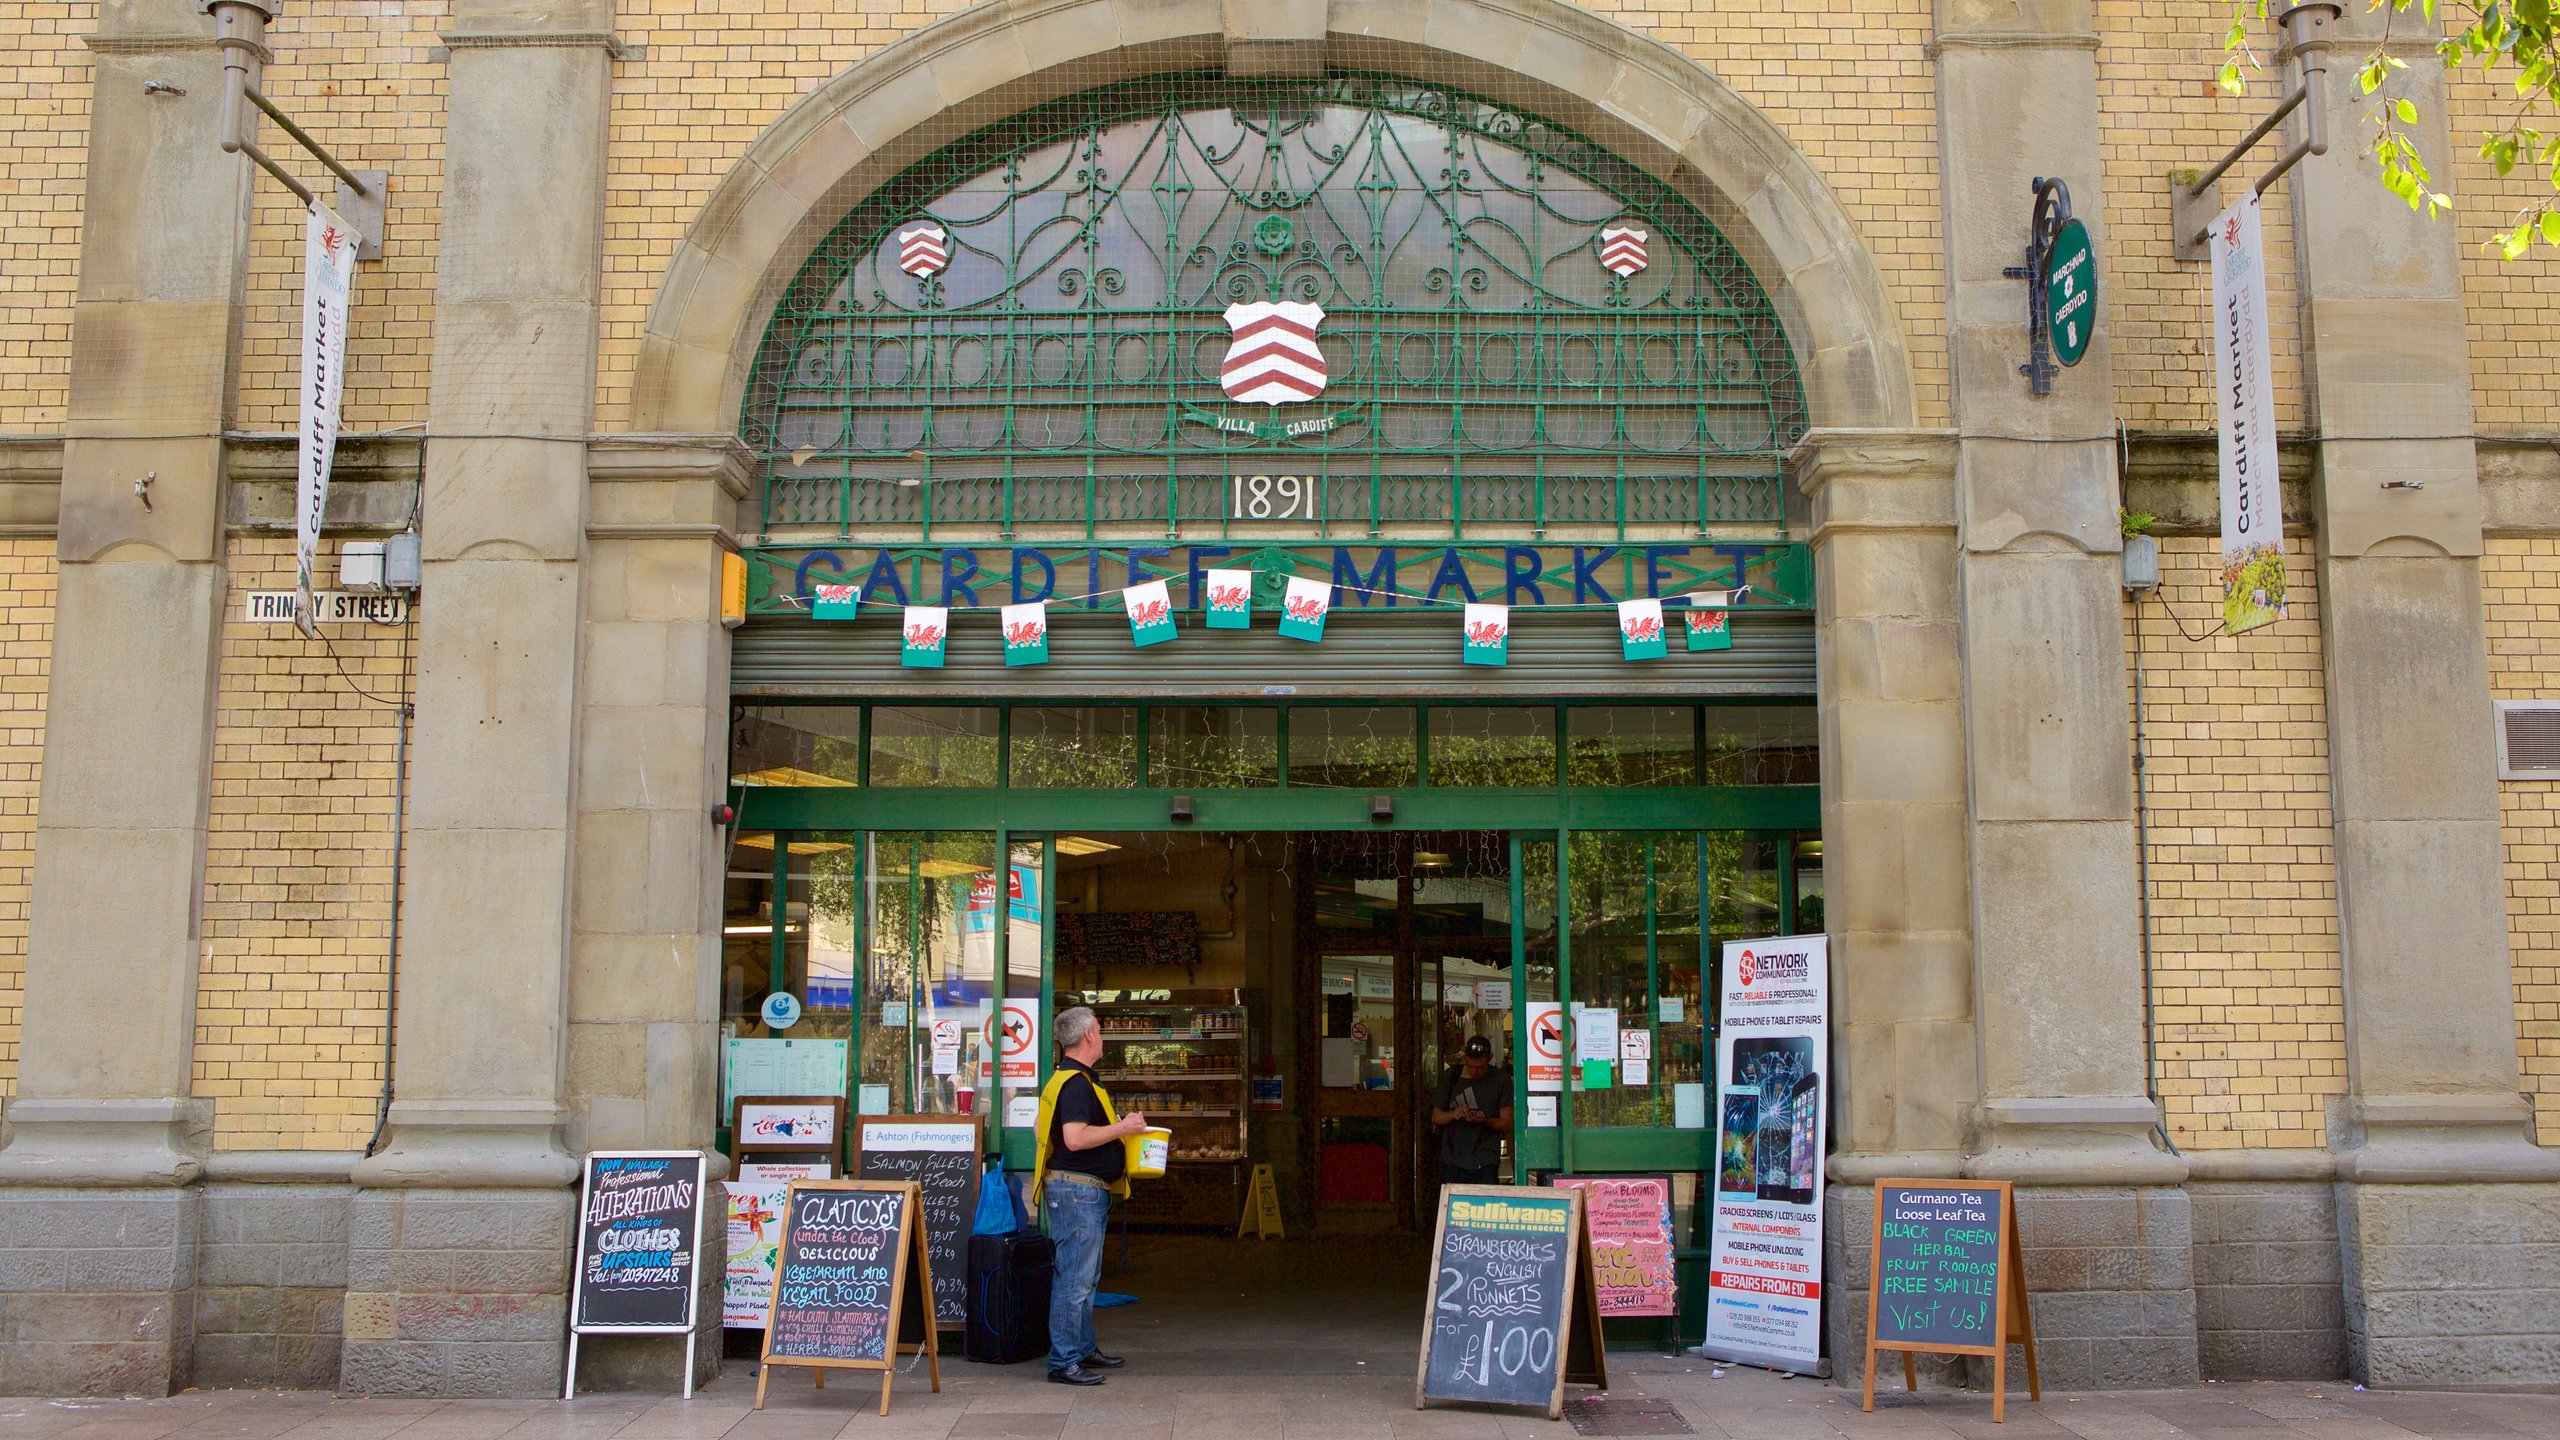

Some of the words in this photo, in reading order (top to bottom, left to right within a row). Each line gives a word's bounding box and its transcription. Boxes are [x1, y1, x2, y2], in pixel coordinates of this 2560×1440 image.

[2053, 248, 2086, 286] MARCHNAD
[2055, 290, 2087, 324] CAERDYDD
[2240, 284, 2257, 400] Caerdydd
[314, 295, 327, 411] Market
[2227, 294, 2244, 410] Market
[1217, 417, 1255, 434] VILLA
[1286, 417, 1334, 436] CARDIFF
[310, 417, 325, 535] Cardiff
[2233, 418, 2250, 534] Cardiff
[1234, 475, 1314, 519] 1891
[795, 547, 1231, 609] CARDIFF
[1330, 546, 1766, 607] MARKET
[252, 595, 324, 618] TRINY
[335, 595, 402, 618] STREET
[1756, 952, 1808, 970] NETWORK
[1755, 968, 1808, 980] COMMUNICATIONS
[1744, 991, 1768, 1000] RELIABLE
[1773, 989, 1818, 999] PROFESSIONAL!
[1724, 1017, 1746, 1027] MOBILE
[1746, 1017, 1765, 1026] PHONE
[1771, 1016, 1794, 1025] TABLET
[1794, 1015, 1822, 1025] REPAIRS
[865, 1132, 874, 1141] E.
[876, 1131, 909, 1141] Ashton
[910, 1131, 974, 1144] (Fishmongers)
[597, 1159, 624, 1175] NOW
[624, 1160, 670, 1171] AVAILABLE
[866, 1153, 921, 1172] SALMON
[925, 1153, 970, 1171] FILLETS
[600, 1168, 664, 1189] Professional
[1620, 1185, 1656, 1196] BLOOMS
[1900, 1192, 1957, 1205] Gurmano
[1960, 1193, 1982, 1205] Tea
[801, 1194, 897, 1228] CLANCY'S
[1451, 1200, 1567, 1225] Sullivans
[1719, 1206, 1746, 1217] CRACKED
[1746, 1208, 1773, 1219] SCREENS
[1796, 1213, 1816, 1223] GLASS
[1895, 1208, 1932, 1221] Loose
[1936, 1208, 1962, 1221] Leaf
[1964, 1209, 1986, 1222] Tea
[613, 1220, 627, 1228] ALL
[1471, 1222, 1497, 1230] CLASS
[1732, 1222, 1761, 1233] INTERNAL
[1761, 1224, 1801, 1236] COMPONENTS
[598, 1227, 681, 1253] CLOTHES
[832, 1230, 847, 1244] the
[851, 1230, 887, 1250] Clock)
[1882, 1222, 1929, 1239] BLACK
[1944, 1228, 1997, 1246] GREEN
[799, 1246, 880, 1262] DELICIOUS
[1445, 1233, 1556, 1261] STRAWBERRIES
[1728, 1241, 1749, 1251] MOBILE
[1750, 1242, 1771, 1254] PHONE
[1771, 1245, 1804, 1256] UNLOCKING
[1913, 1243, 1970, 1259] HERBAL
[601, 1251, 673, 1270] UPSTAIRS
[1722, 1256, 1734, 1264] BUY
[1739, 1257, 1753, 1267] SELL
[1753, 1259, 1779, 1270] PHONES
[1786, 1262, 1809, 1274] TABLETS
[1886, 1259, 1929, 1272] FRUIT
[1939, 1260, 1997, 1276] ROOIBOS
[587, 1268, 609, 1283] Tel:
[621, 1268, 679, 1283] 20397248
[785, 1264, 858, 1283] VEGETARIAN
[861, 1266, 888, 1280] AND
[1437, 1267, 1464, 1312] 2
[1467, 1276, 1541, 1305] PUNNETS
[1721, 1273, 1760, 1291] REPAIRS
[1761, 1278, 1791, 1294] FROM
[1791, 1282, 1806, 1297] £10
[1883, 1276, 1928, 1295] FREE
[1934, 1277, 1992, 1296] SAMPLE
[782, 1285, 832, 1308] VEGAN
[835, 1285, 878, 1302] FOOD
[831, 1311, 879, 1326] SLAMMERS
[1435, 1316, 1468, 1335] For
[786, 1343, 820, 1356] HERBS
